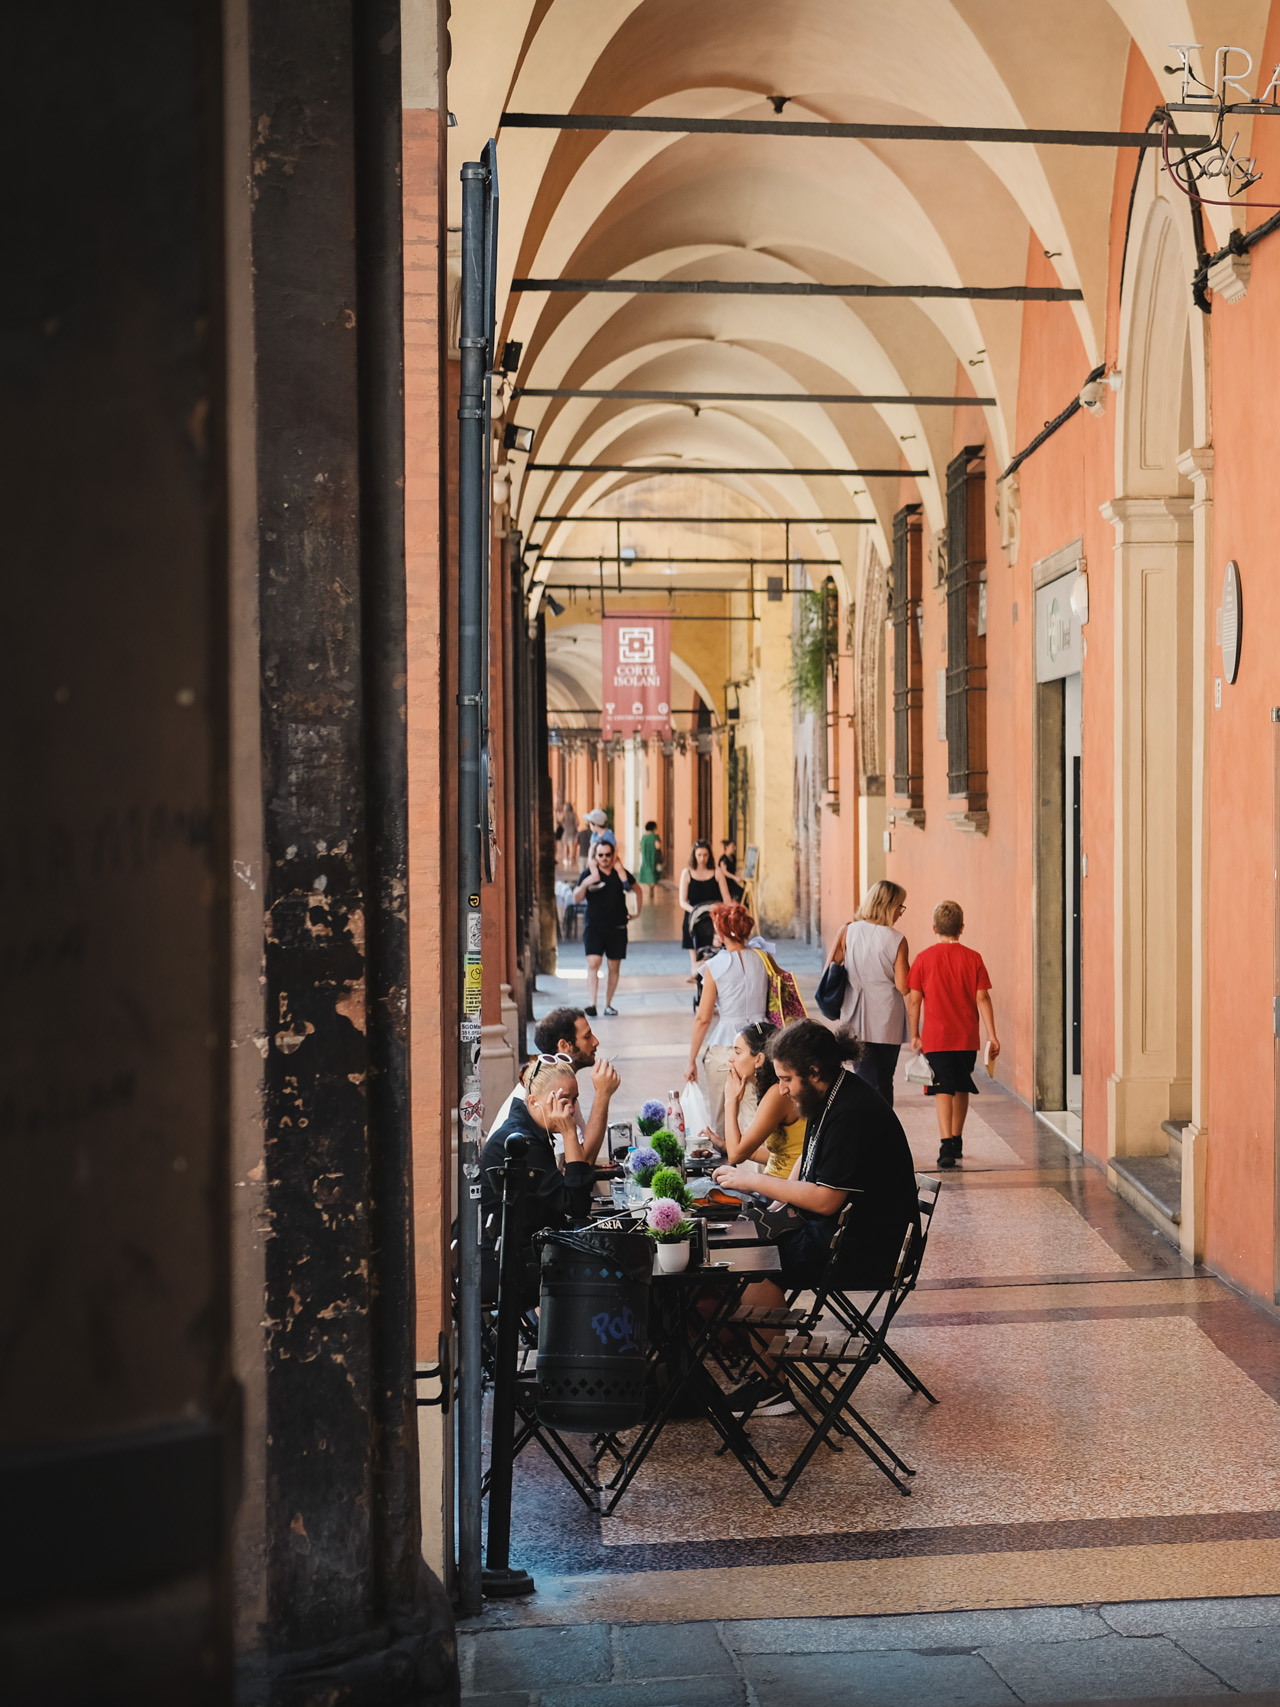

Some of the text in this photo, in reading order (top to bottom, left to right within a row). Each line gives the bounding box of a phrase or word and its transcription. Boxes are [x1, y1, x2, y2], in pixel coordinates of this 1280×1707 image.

[1204, 131, 1263, 181] da
[616, 664, 657, 676] CORTE
[613, 675, 661, 687] ISOLANI
